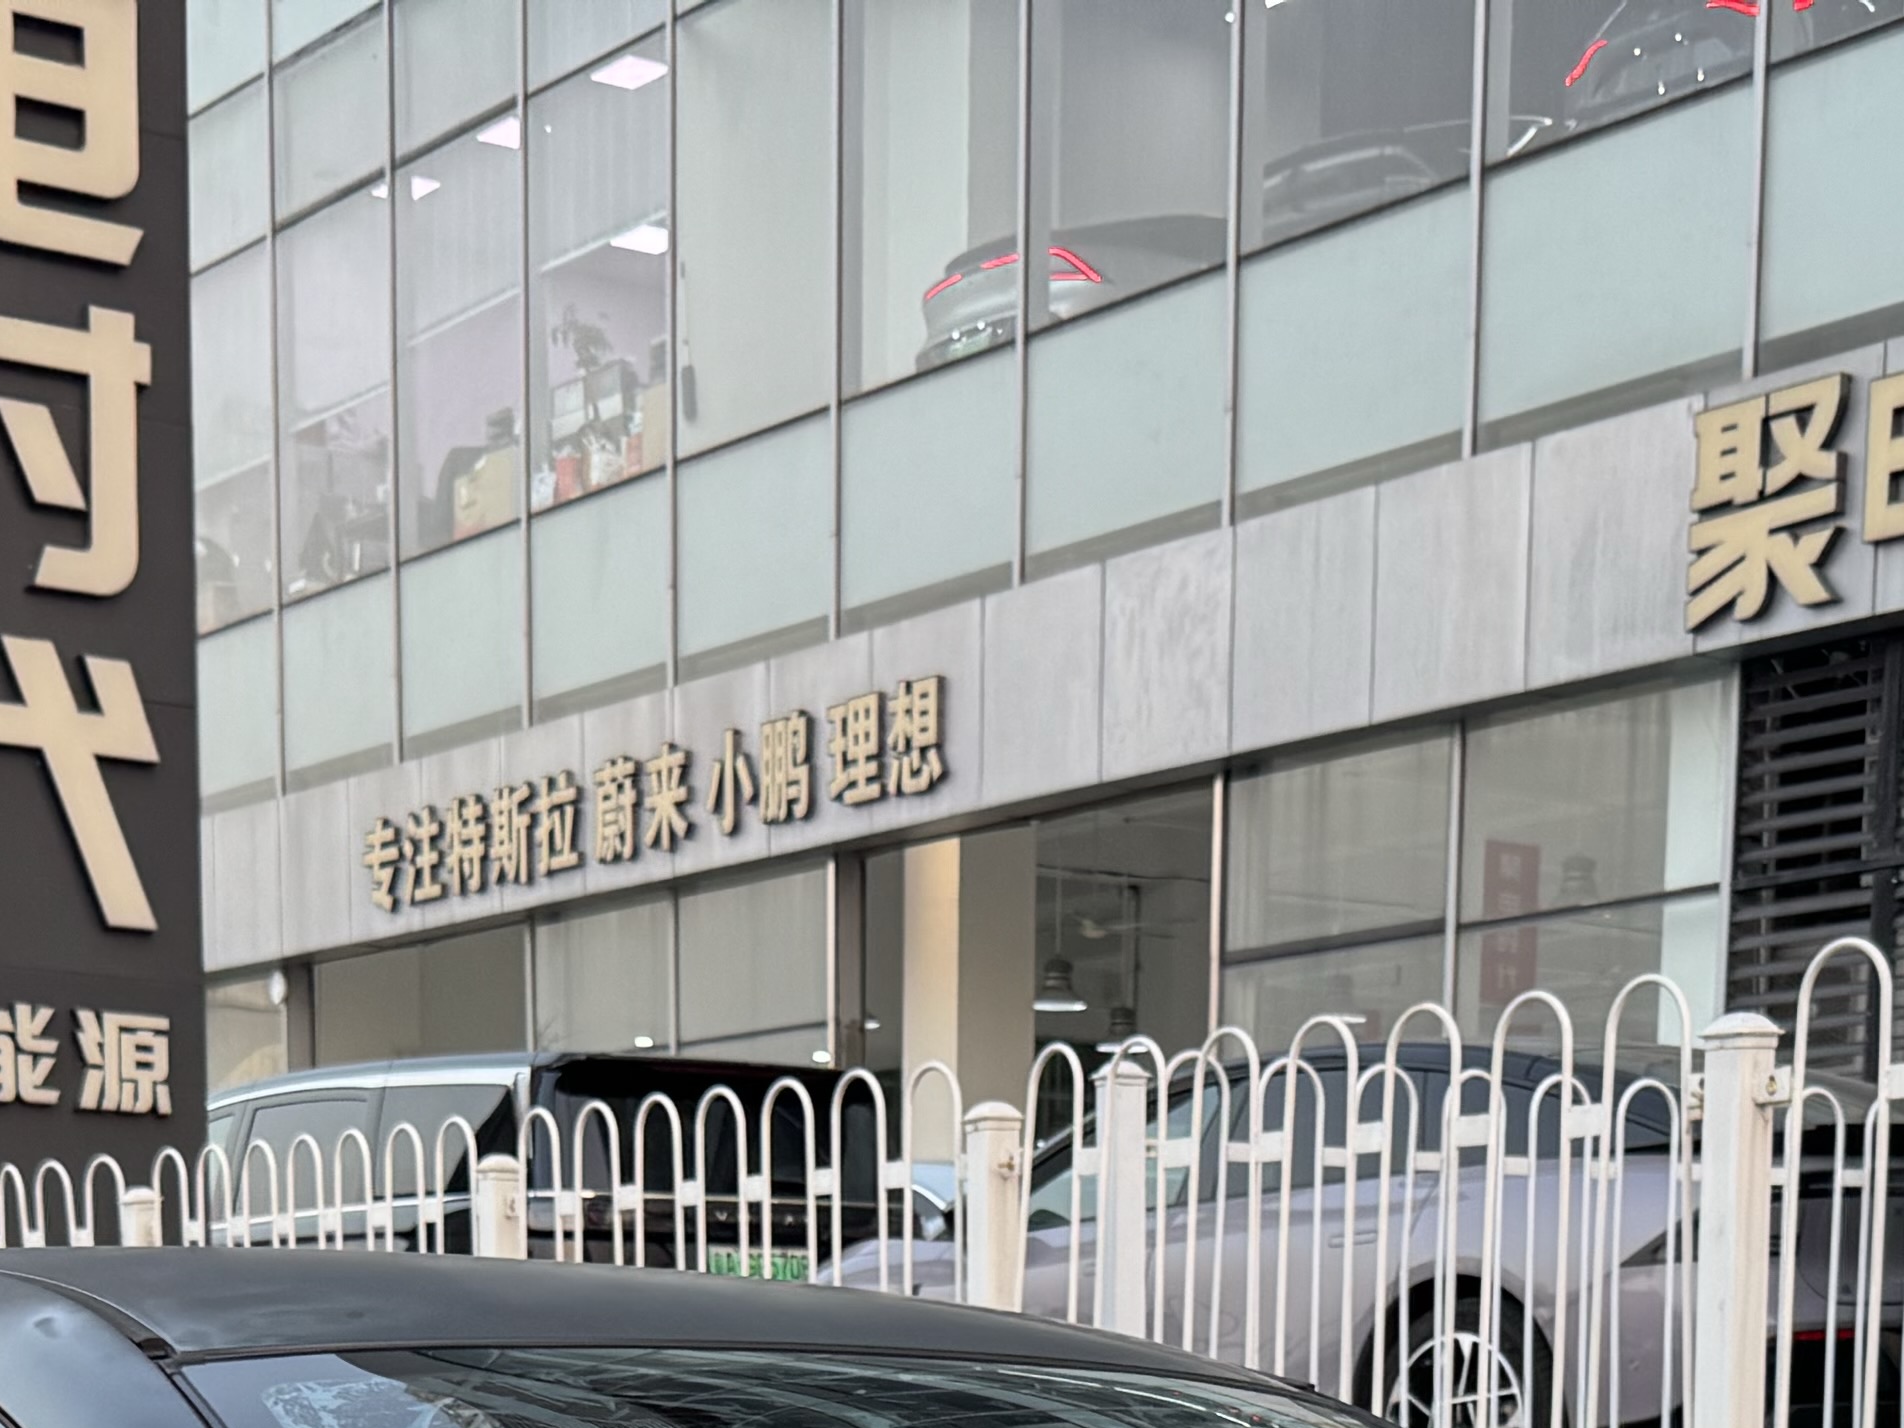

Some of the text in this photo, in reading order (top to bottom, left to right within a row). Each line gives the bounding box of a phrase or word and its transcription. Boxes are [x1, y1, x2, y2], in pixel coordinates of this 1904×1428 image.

[363, 675, 948, 912] 专注特斯拉 蔚来 小鹏 理想
